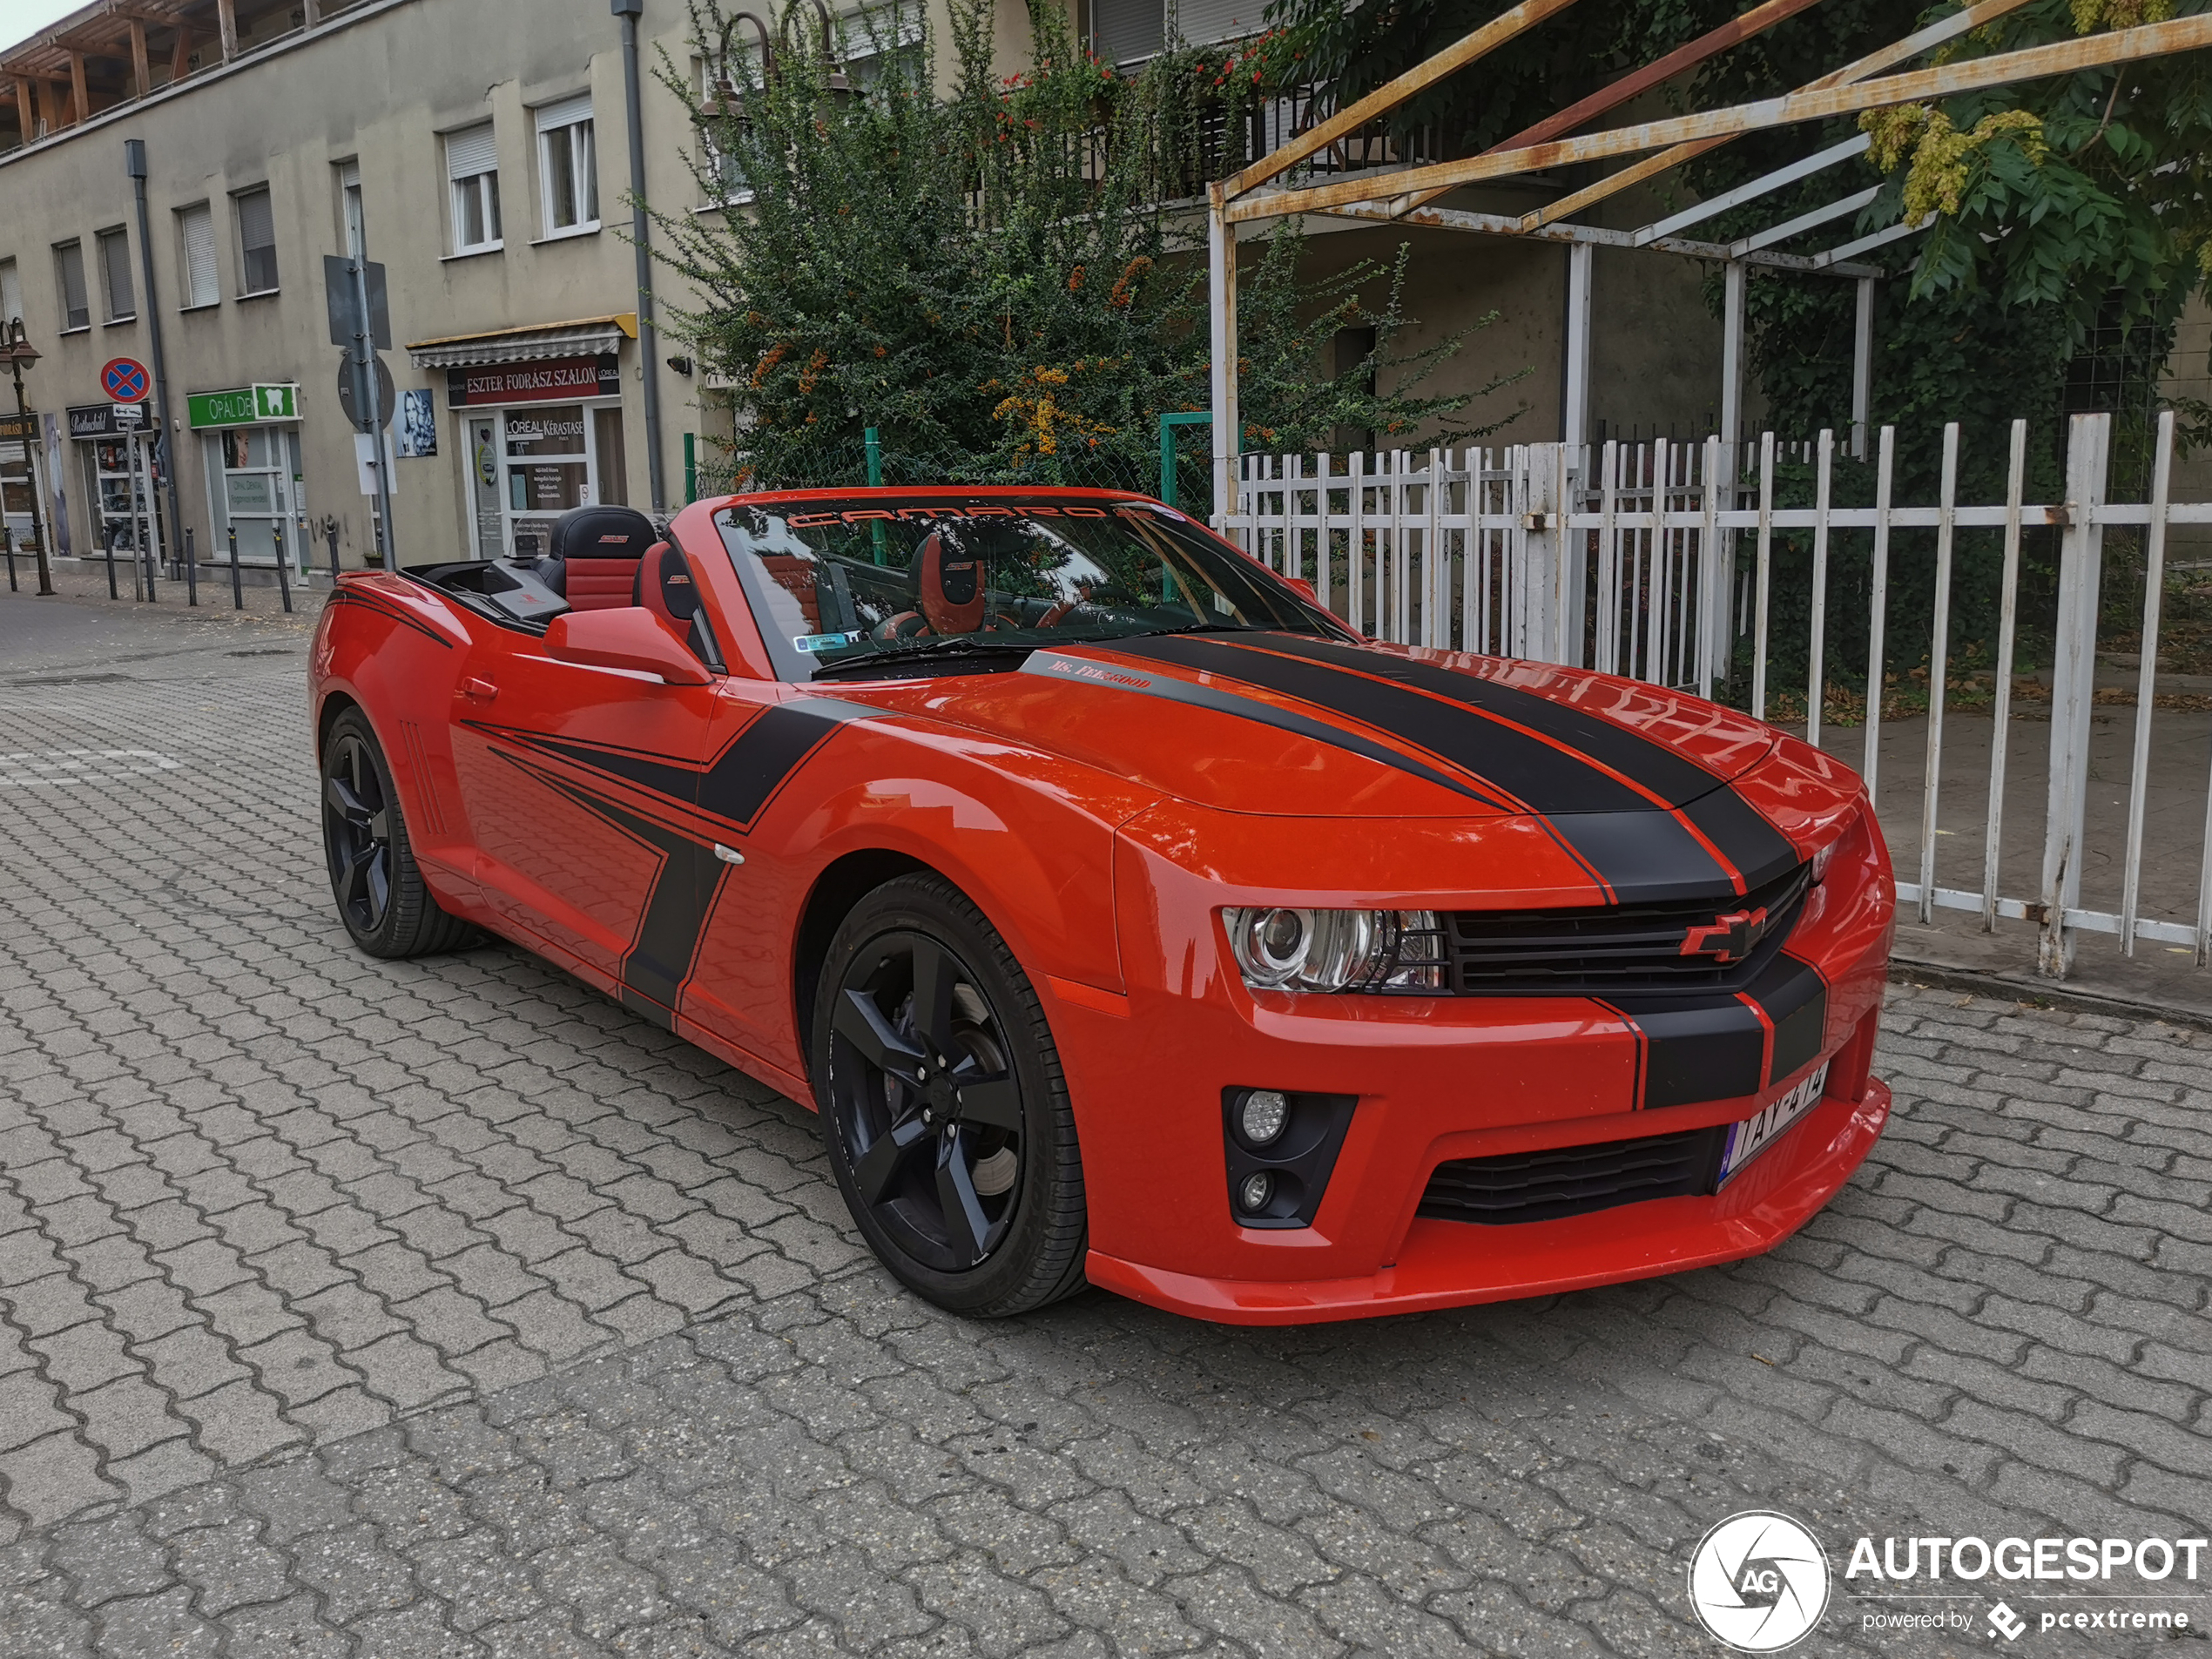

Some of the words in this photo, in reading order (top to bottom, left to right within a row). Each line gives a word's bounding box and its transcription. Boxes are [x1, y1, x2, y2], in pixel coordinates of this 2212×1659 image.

[467, 376, 504, 393] ESZTER
[506, 368, 553, 390] FODRÁSZ
[554, 367, 597, 387] SZALON
[543, 420, 583, 435] KÉRASTASE
[786, 506, 1108, 529] CAMARO
